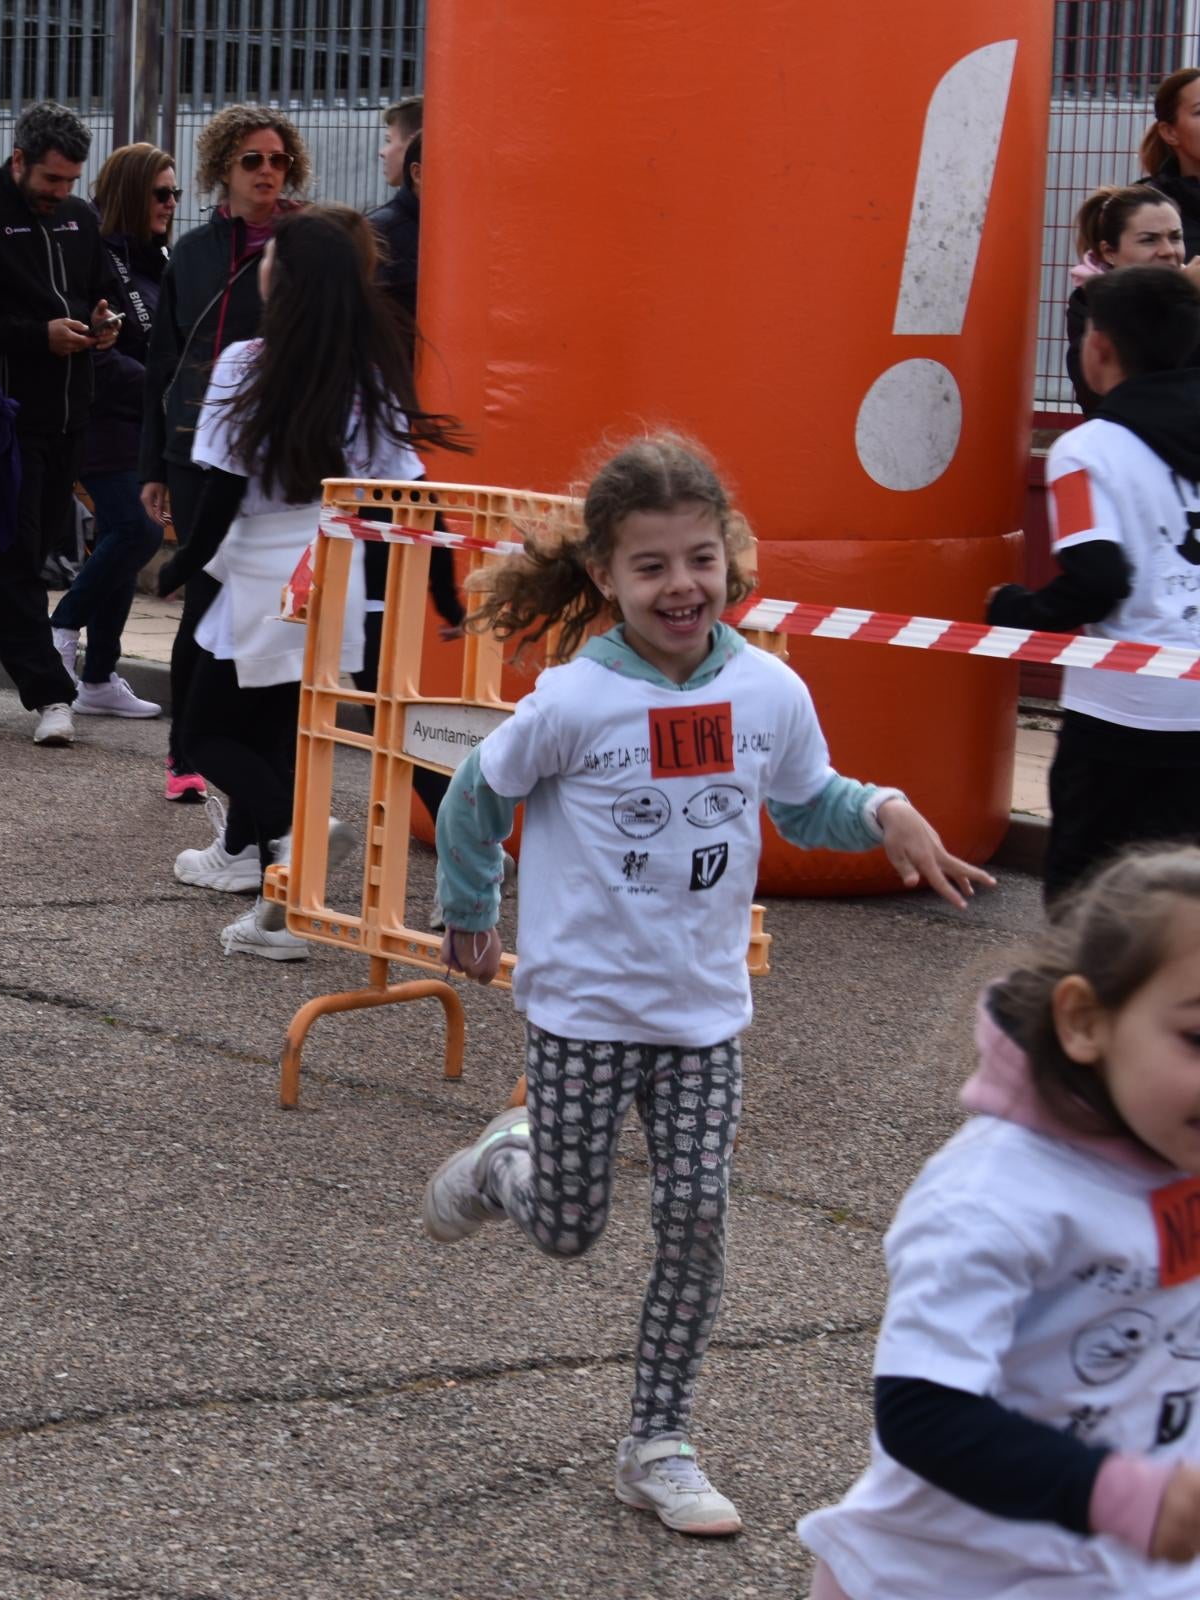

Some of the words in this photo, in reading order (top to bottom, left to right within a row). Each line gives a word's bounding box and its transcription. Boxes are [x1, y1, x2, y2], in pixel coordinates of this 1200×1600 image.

[129, 291, 152, 332] BIMBA
[413, 720, 484, 748] Ayuntamien
[737, 733, 748, 753] LA
[603, 751, 616, 769] DE
[618, 747, 632, 768] LA
